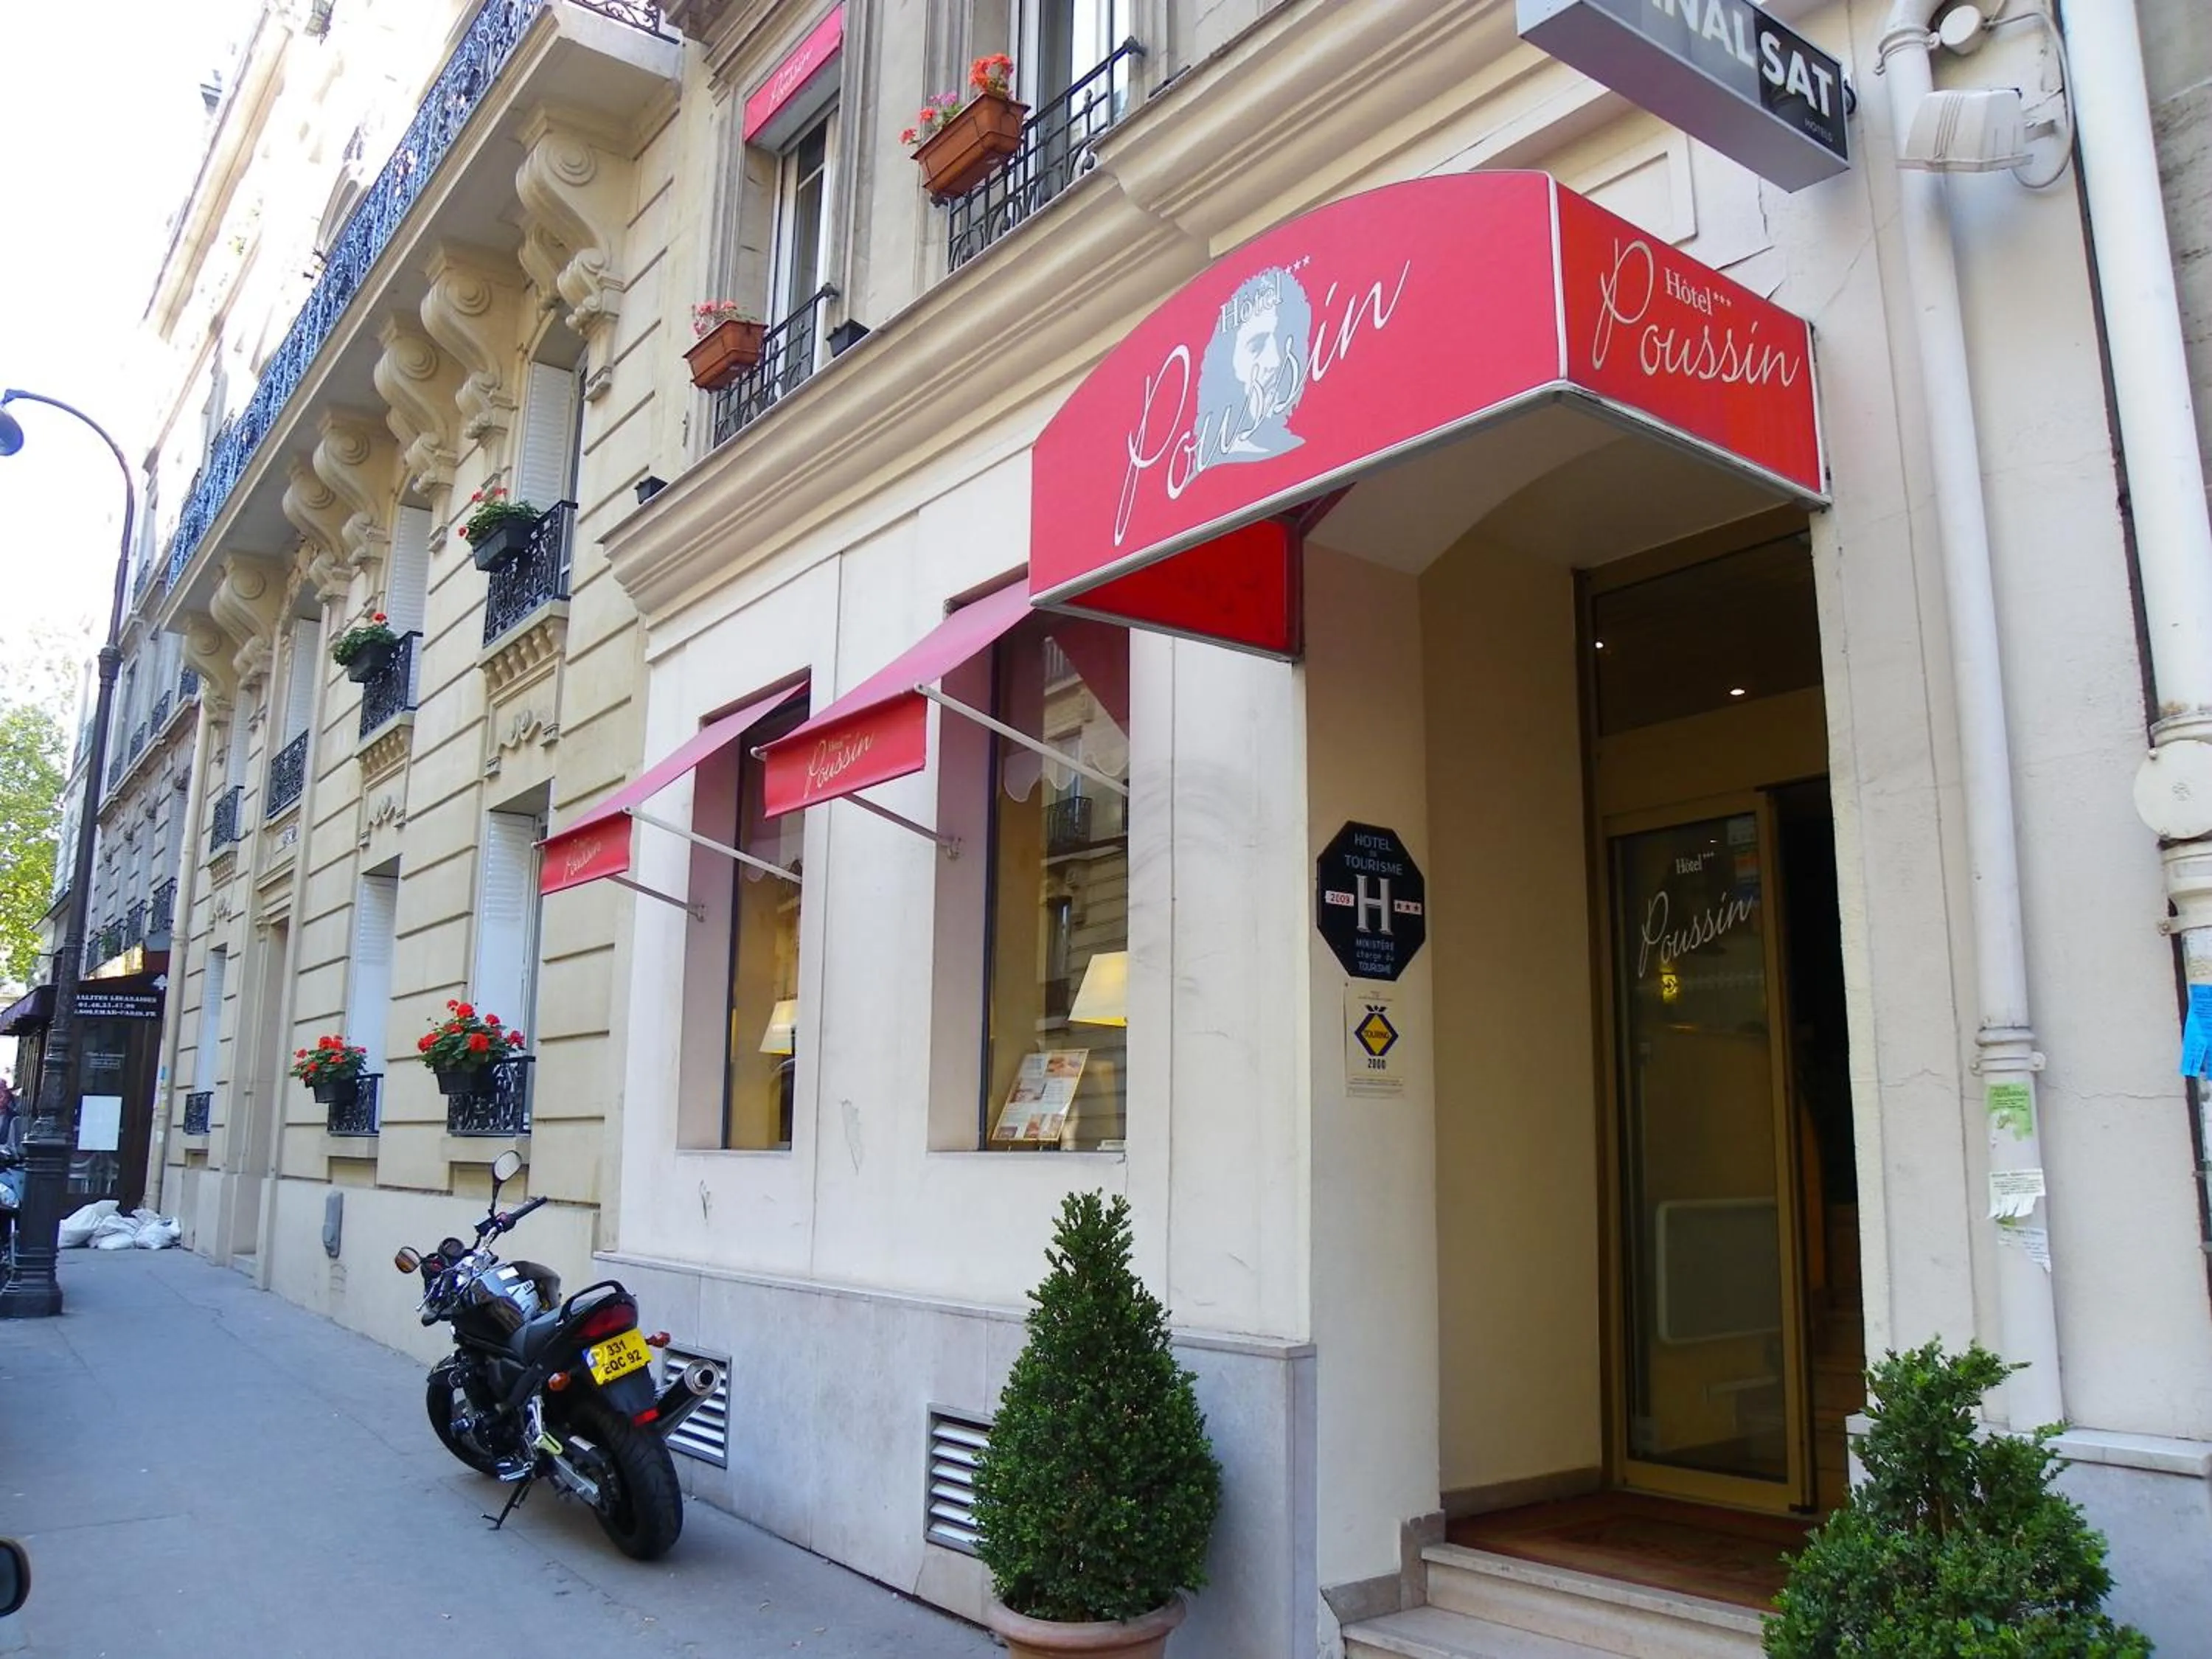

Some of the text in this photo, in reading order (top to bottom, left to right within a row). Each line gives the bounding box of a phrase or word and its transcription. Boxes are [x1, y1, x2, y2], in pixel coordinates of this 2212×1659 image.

[1593, 237, 1800, 387] Poussin
[1114, 260, 1411, 546] Poussin
[804, 732, 874, 799] Poussin
[1344, 854, 1403, 876] TOURISME
[1354, 832, 1393, 852] HOTEL
[1356, 874, 1393, 935] H
[1638, 891, 1753, 979] Poussin
[606, 1339, 627, 1356] 331
[626, 1349, 642, 1363] 92
